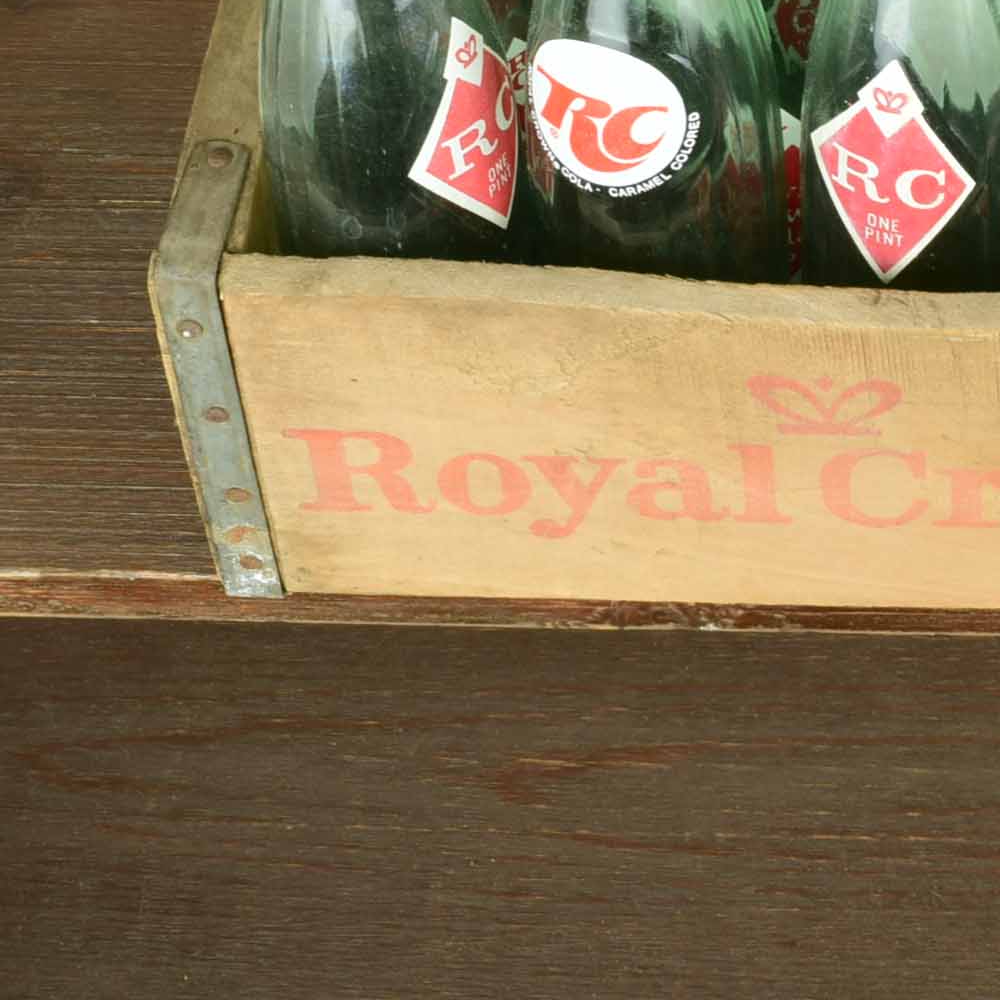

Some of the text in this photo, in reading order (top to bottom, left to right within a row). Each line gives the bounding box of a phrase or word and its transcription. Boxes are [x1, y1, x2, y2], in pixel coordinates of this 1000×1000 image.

[535, 64, 669, 173] RC
[486, 151, 509, 183] ONE
[560, 166, 594, 193] COLA
[609, 172, 672, 198] CARAMEL
[670, 111, 701, 171] COLORED
[831, 142, 947, 211] RC
[487, 164, 514, 199] PINT
[864, 228, 905, 248] PINT
[866, 212, 900, 233] ONE
[282, 427, 793, 539] Royal
